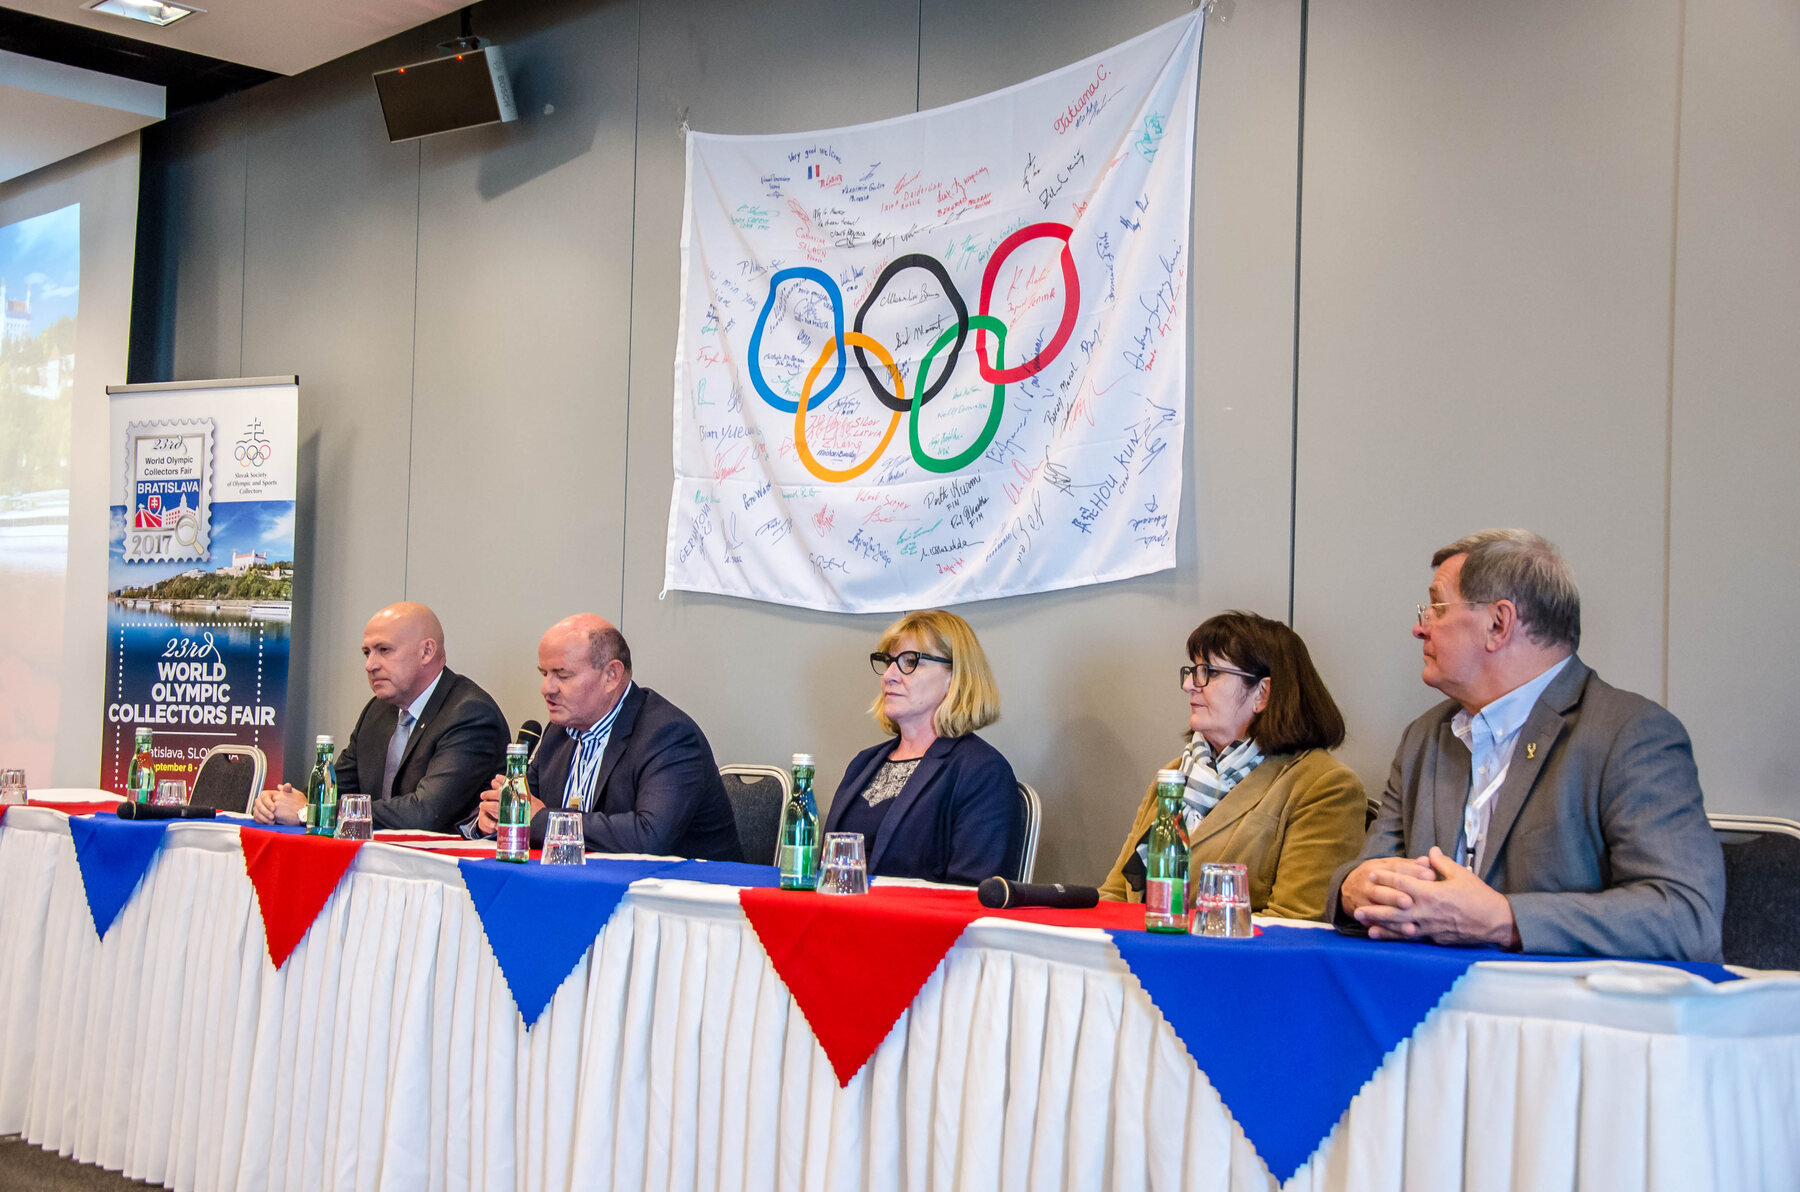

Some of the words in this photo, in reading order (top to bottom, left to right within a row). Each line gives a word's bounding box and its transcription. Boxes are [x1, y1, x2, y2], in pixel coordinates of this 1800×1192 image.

[145, 456, 165, 465] World
[166, 456, 194, 466] Olympic
[143, 468, 179, 476] Collectors
[180, 467, 193, 475] Fair
[234, 471, 249, 479] Slovak
[250, 471, 267, 479] Society
[137, 481, 199, 494] BRATISLAVA
[232, 480, 251, 488] Olympic
[251, 479, 262, 487] and
[262, 479, 278, 487] Sports
[131, 534, 173, 555] 2017
[161, 631, 222, 664] 23rd
[157, 662, 227, 682] WORLD
[151, 682, 231, 704] OLYMPIC
[108, 703, 227, 726] COLLECTORS
[231, 705, 276, 726] FAIR
[150, 746, 186, 760] atislava,
[154, 762, 186, 772] ptember
[187, 763, 193, 772] 8
